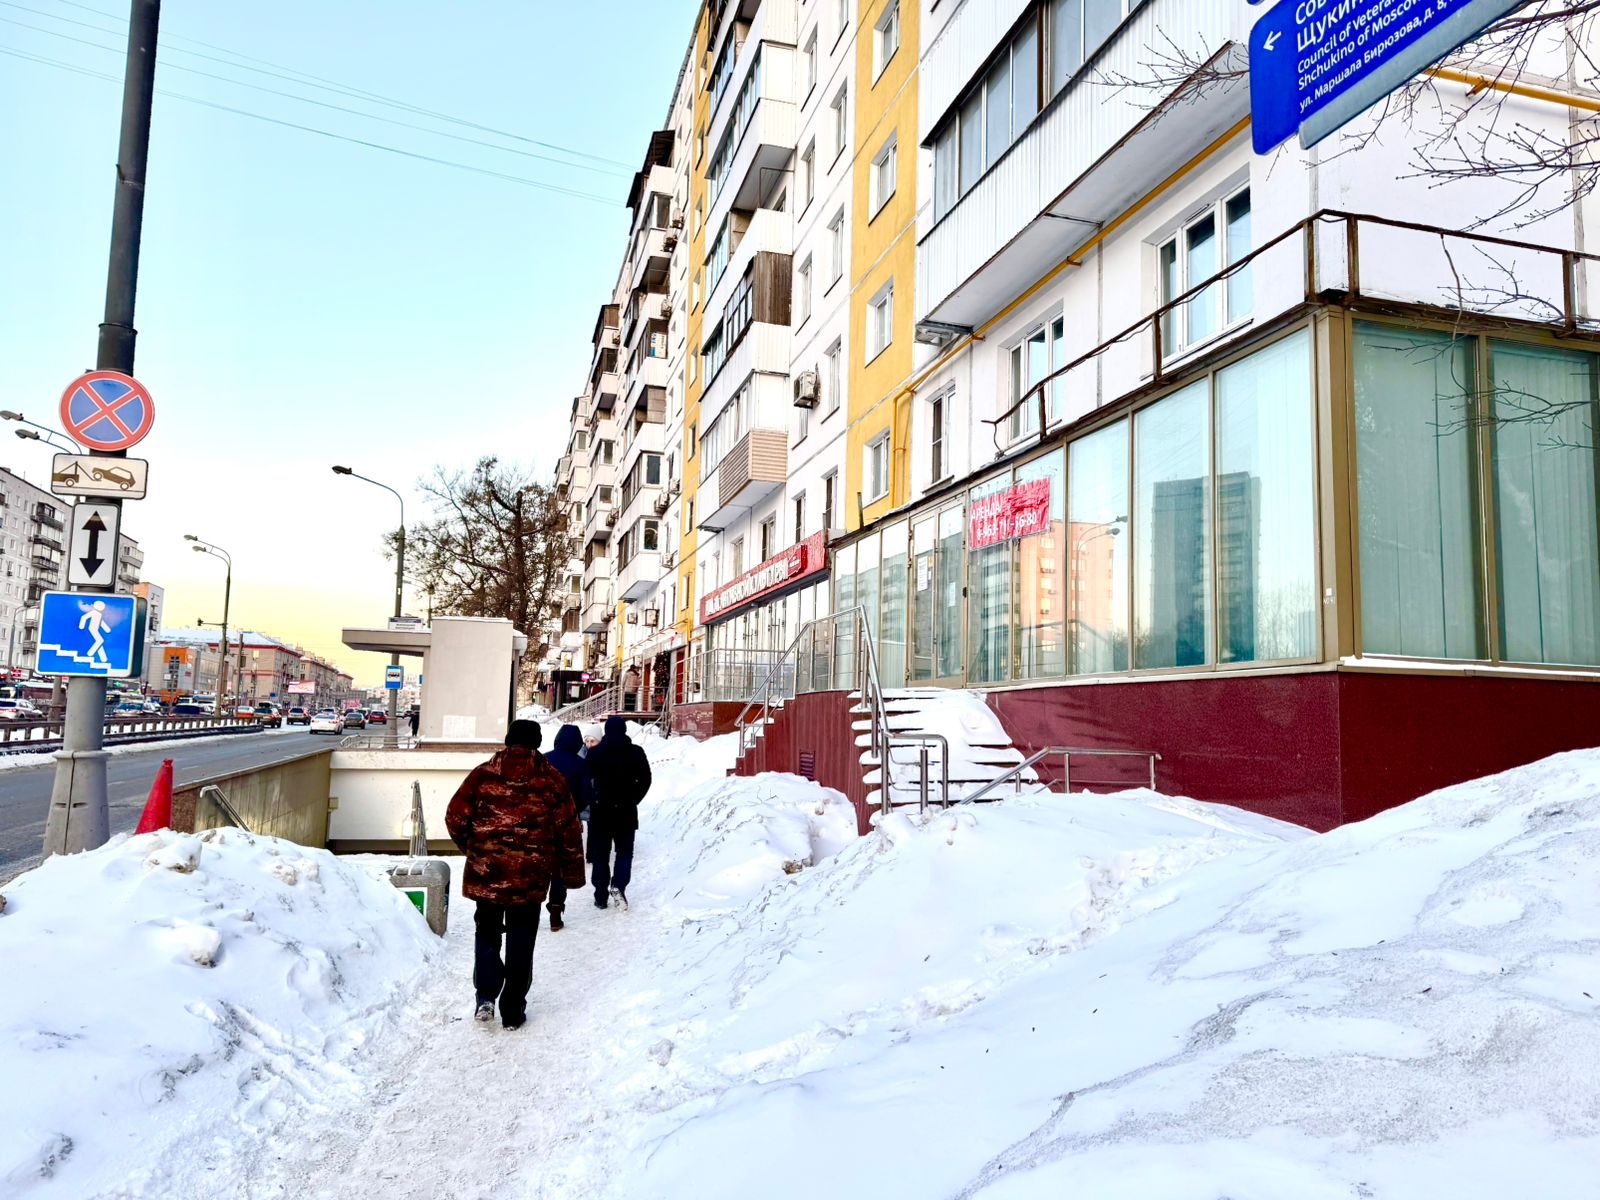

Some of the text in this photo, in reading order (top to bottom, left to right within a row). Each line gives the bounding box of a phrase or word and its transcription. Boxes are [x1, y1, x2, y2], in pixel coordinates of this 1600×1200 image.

[1297, 0, 1396, 74] Council of vetera
[1298, 41, 1355, 91] Shchukino
[1357, 25, 1371, 46] of
[1299, 95, 1314, 114] ул.
[1314, 58, 1363, 100] Маршала
[1363, 16, 1423, 65] Бирюзова,
[1423, 7, 1436, 24] д.
